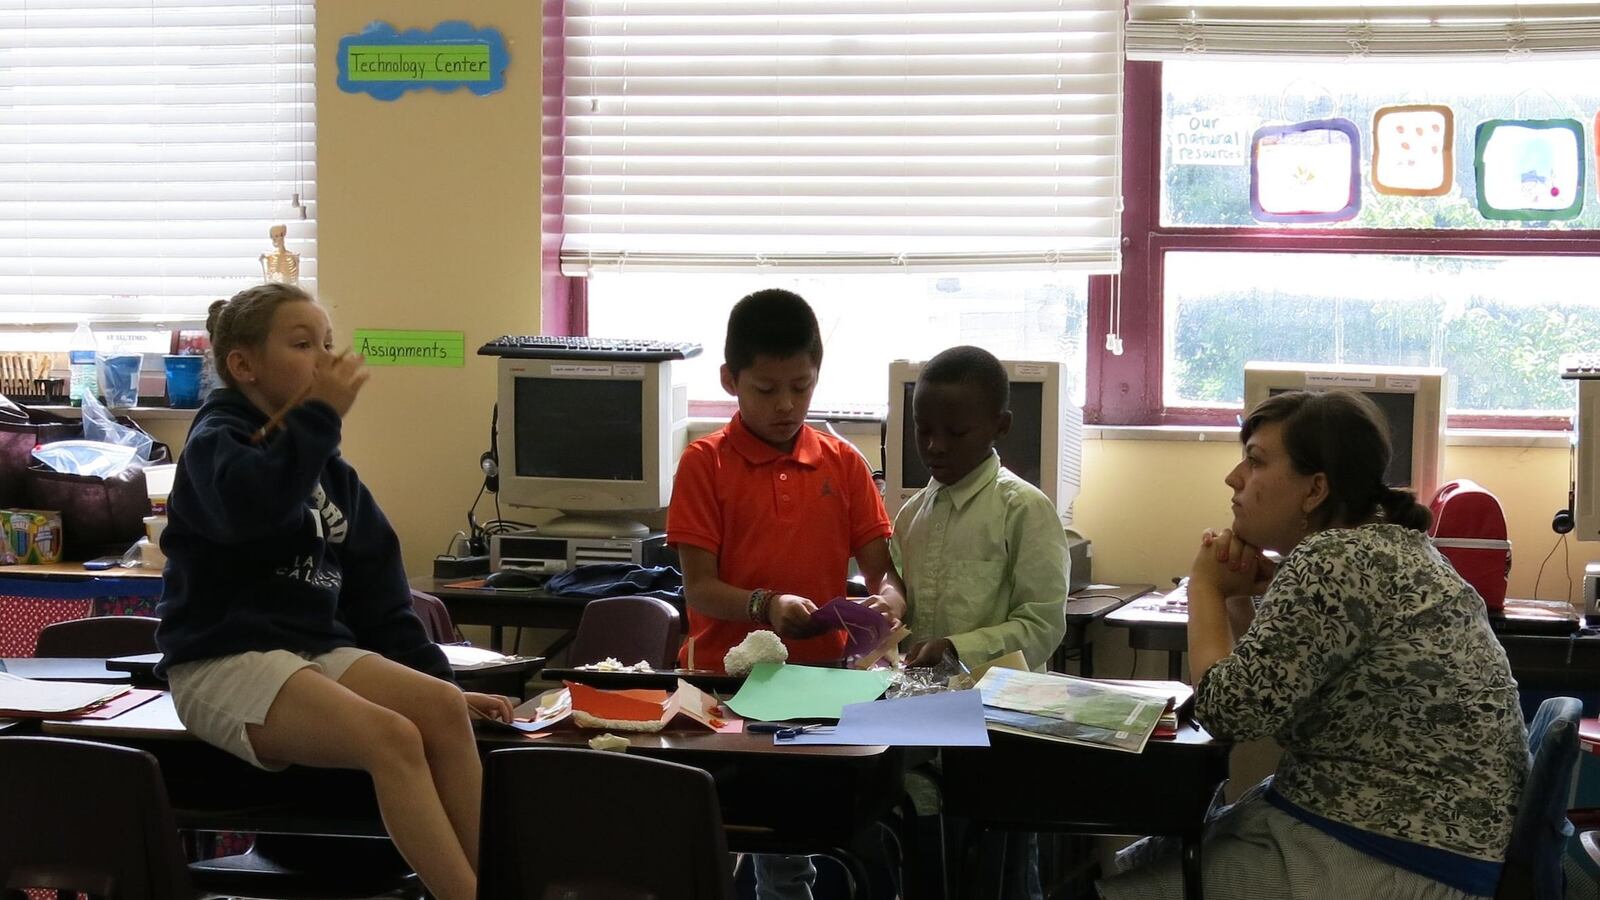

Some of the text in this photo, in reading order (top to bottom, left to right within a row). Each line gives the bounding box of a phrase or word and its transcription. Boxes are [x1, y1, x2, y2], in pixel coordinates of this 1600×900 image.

[350, 53, 488, 79] Technology Center
[1189, 117, 1220, 131] Our
[1178, 131, 1239, 146] natural
[1179, 147, 1241, 160] resources
[361, 337, 447, 362] Assignments
